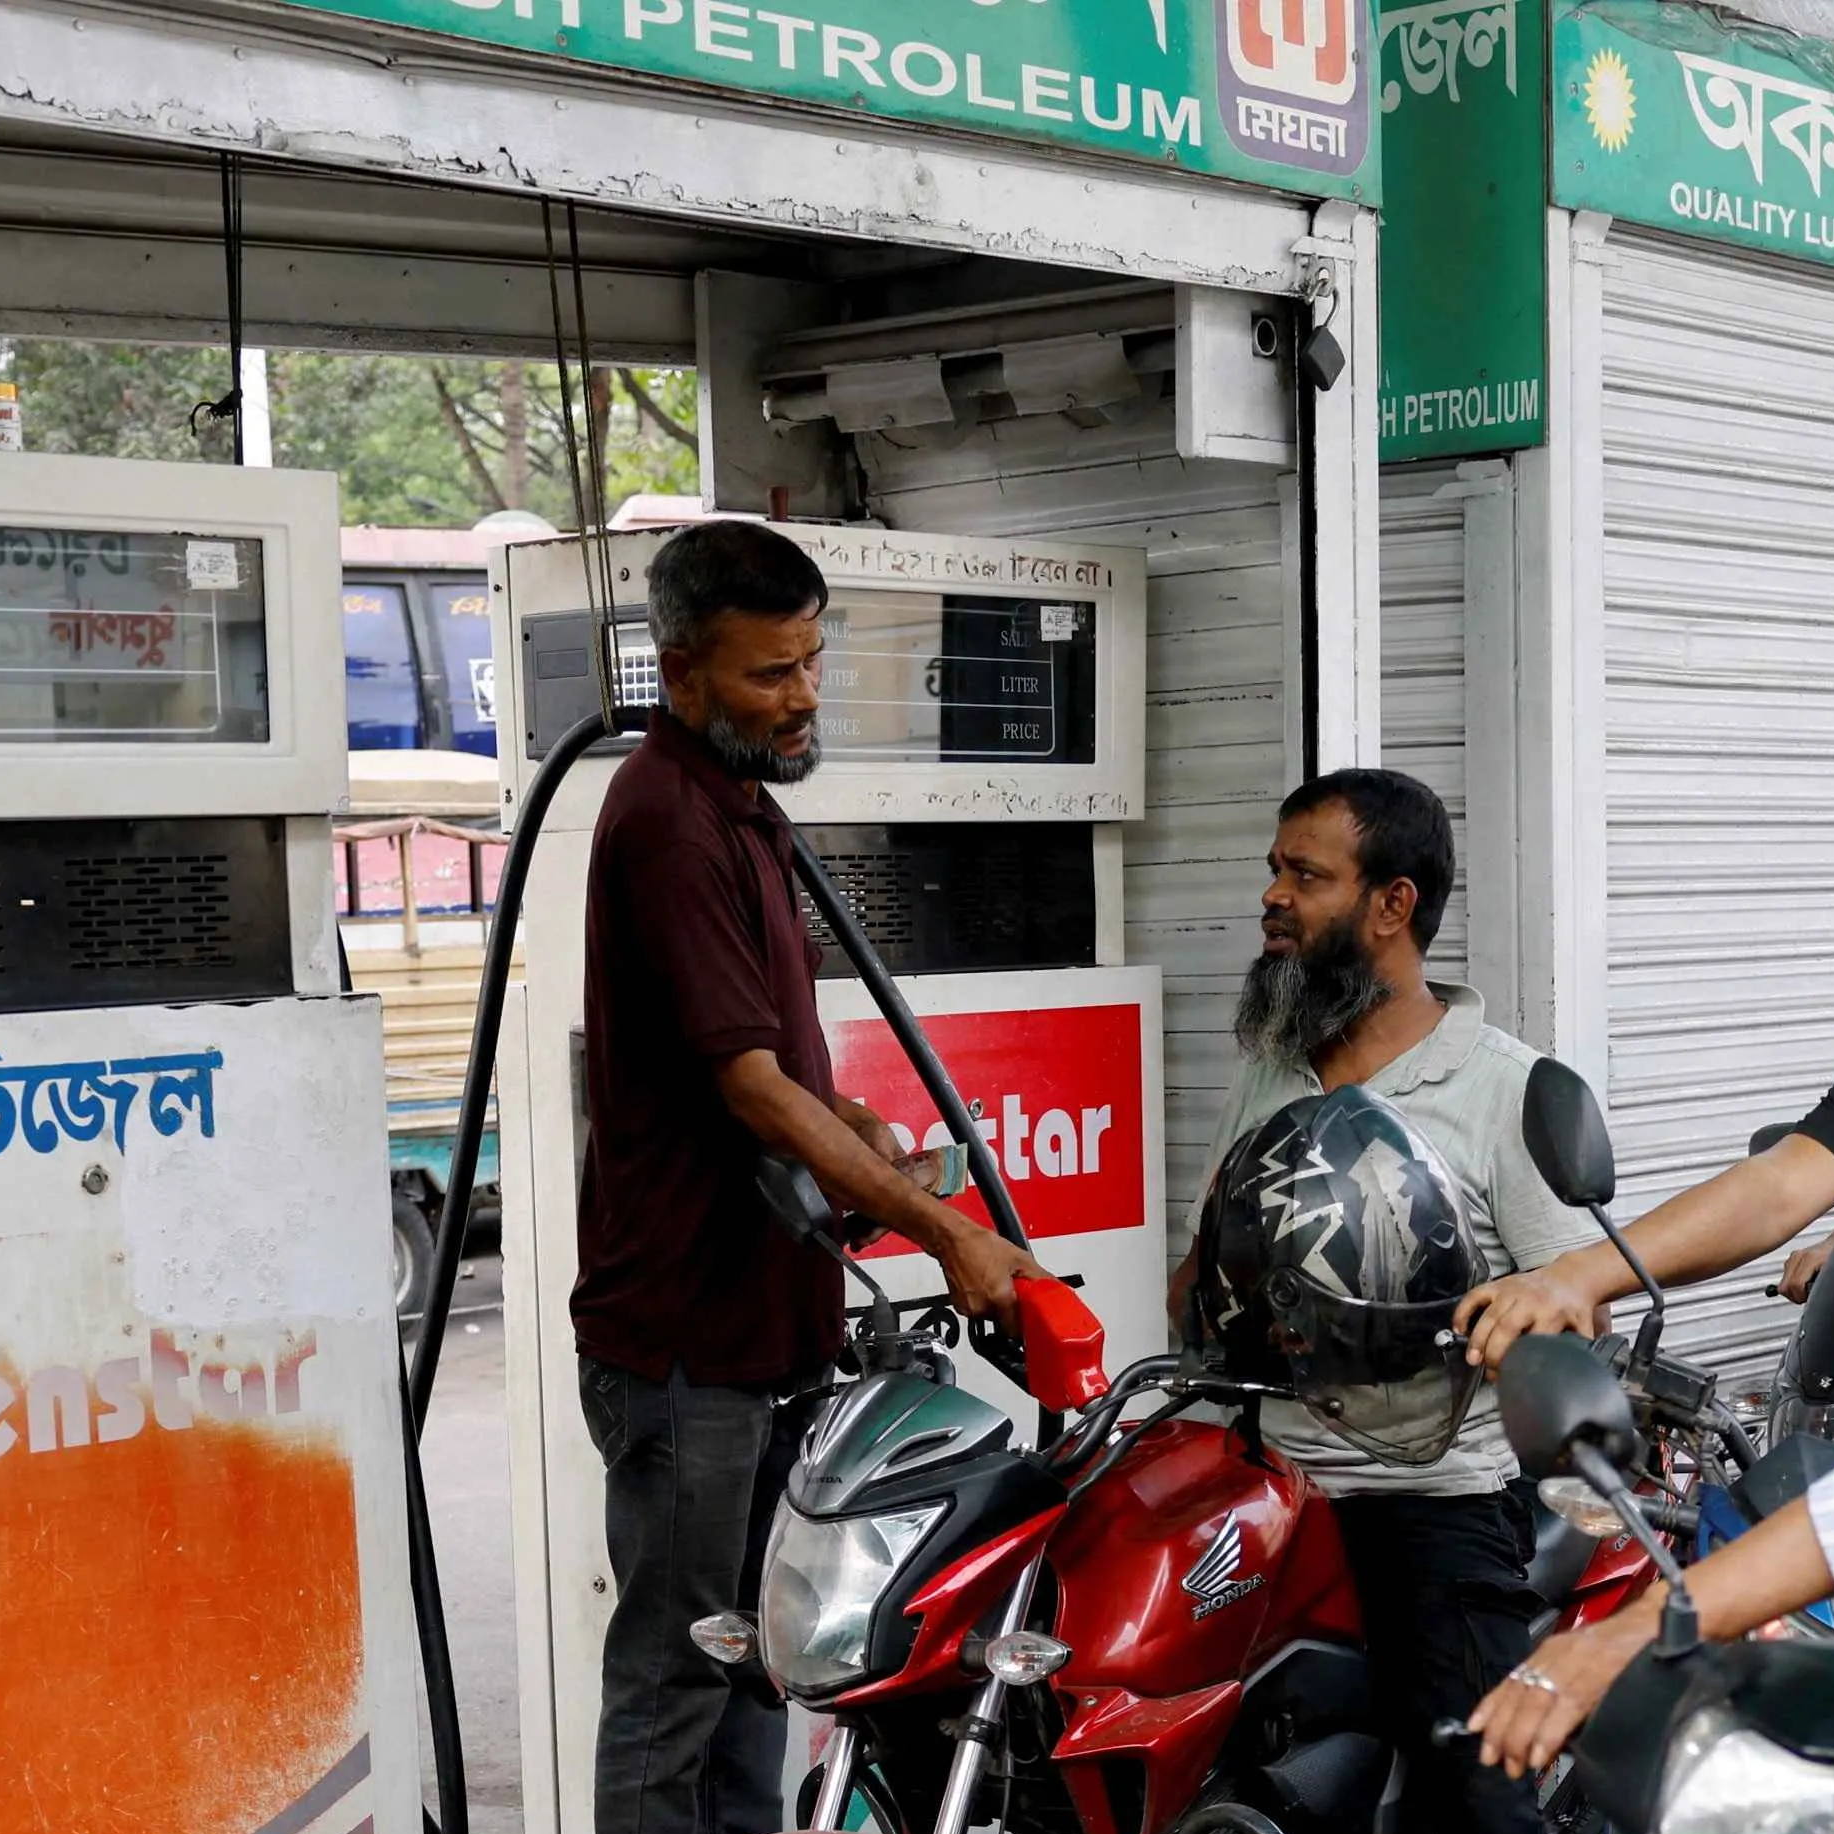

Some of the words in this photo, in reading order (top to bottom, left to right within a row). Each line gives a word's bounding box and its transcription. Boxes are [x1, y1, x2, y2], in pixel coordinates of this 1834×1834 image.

[623, 0, 1203, 146] PETROLEUM
[1236, 96, 1348, 158] মেঘনা
[1670, 182, 1796, 238] QUALITY
[1405, 378, 1539, 435] PETROLIUM
[1001, 675, 1040, 694] LITER
[1002, 722, 1041, 741] PRICE
[1192, 1573, 1266, 1624] HONDA
